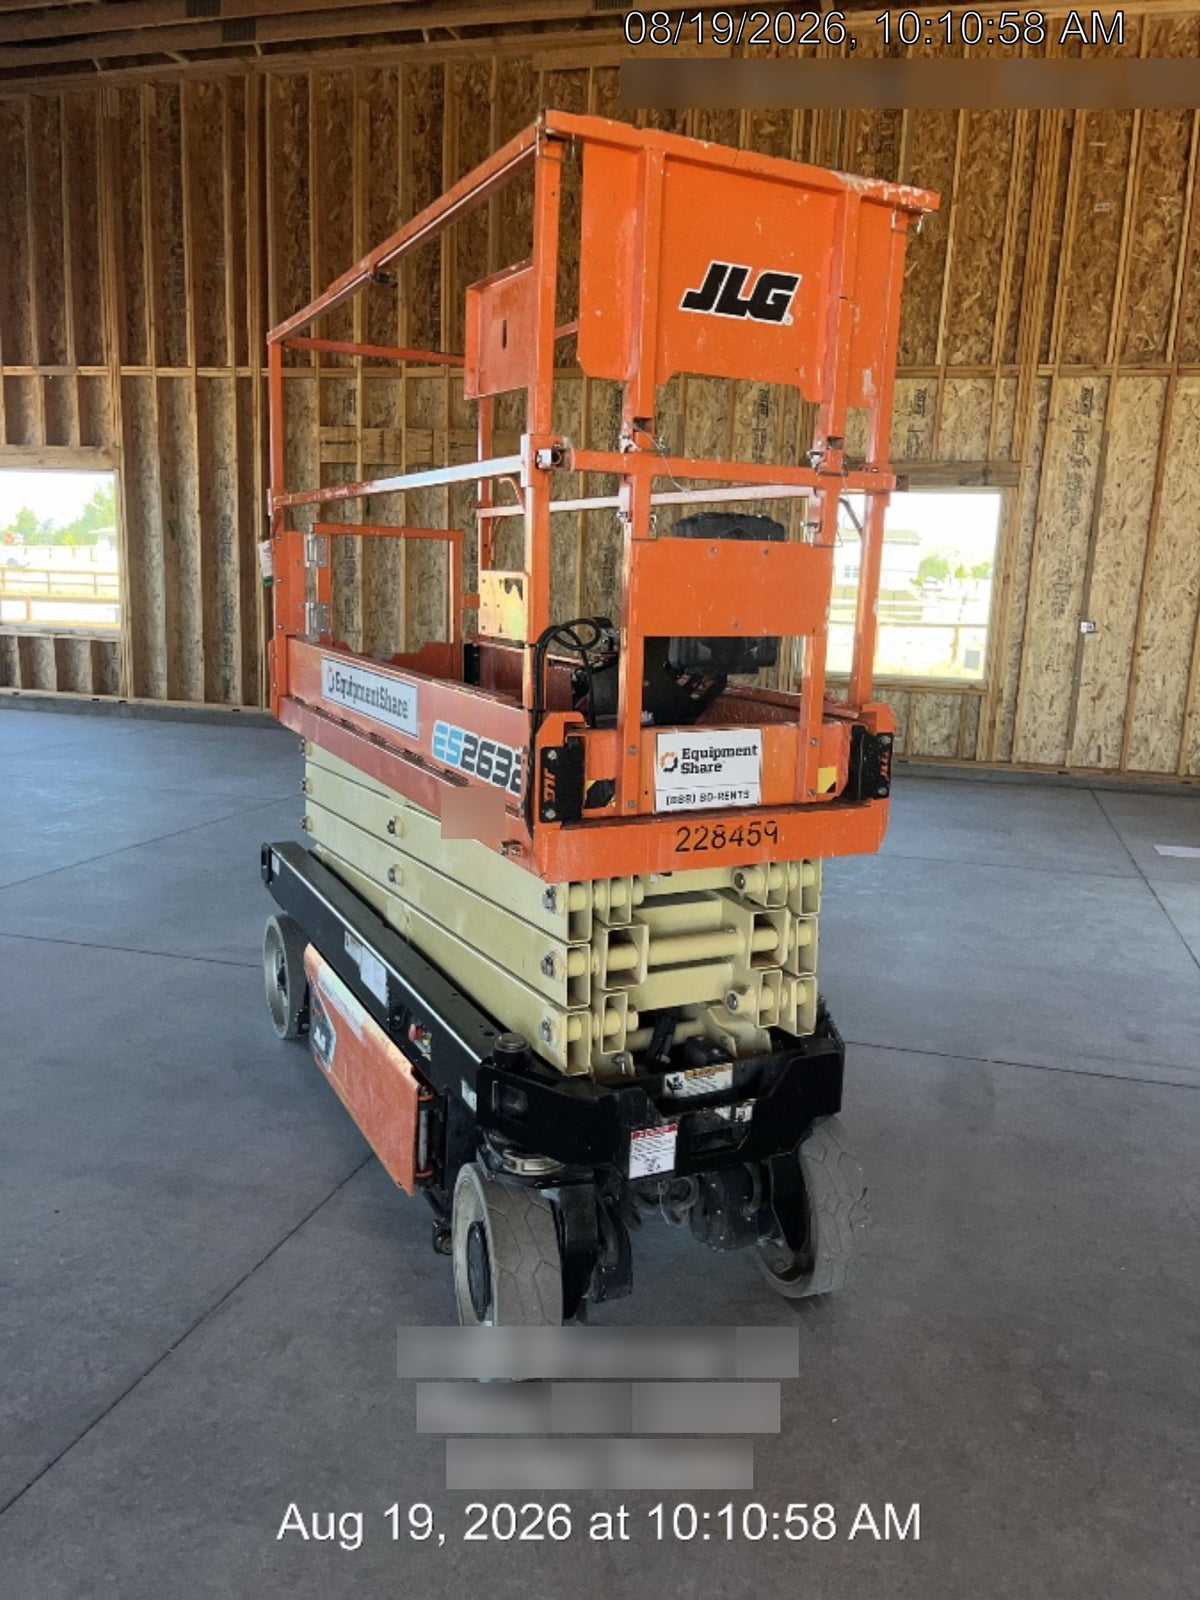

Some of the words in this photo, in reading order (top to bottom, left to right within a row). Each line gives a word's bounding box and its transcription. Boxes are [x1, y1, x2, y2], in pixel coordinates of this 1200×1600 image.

[679, 260, 802, 324] JLG
[335, 671, 409, 719] EquipmentShare
[681, 744, 759, 762] Equipment
[681, 761, 723, 774] Share
[543, 767, 556, 803] JLG
[675, 820, 778, 853] 228459
